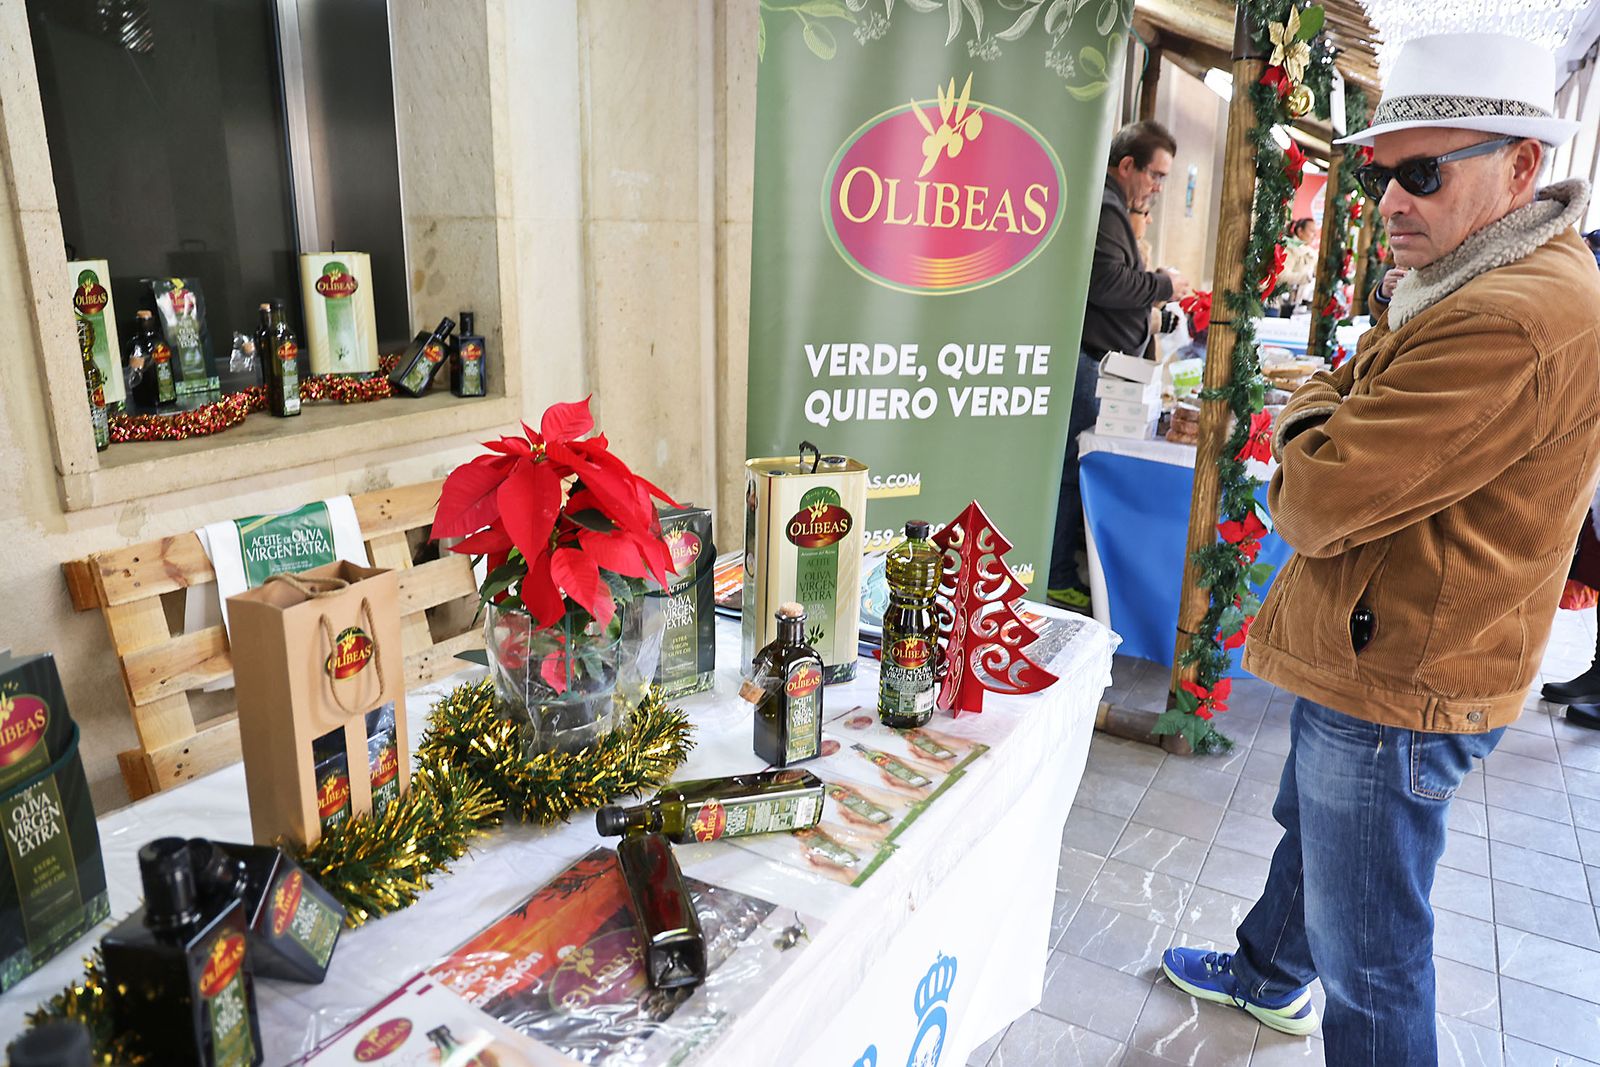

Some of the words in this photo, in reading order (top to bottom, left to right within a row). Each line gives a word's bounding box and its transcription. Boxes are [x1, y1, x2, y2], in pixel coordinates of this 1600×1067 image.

[839, 166, 1049, 235] OLIBEAS
[75, 292, 107, 305] OLIBEAS
[804, 343, 927, 382] VERDE,
[937, 343, 1006, 380] QUE
[1015, 344, 1051, 375] TE
[804, 387, 938, 428] QUIERO
[947, 386, 1051, 417] VERDE
[790, 518, 848, 536] OLIBEAS
[251, 533, 281, 548] ACEITE
[291, 528, 324, 542] OLIVA
[246, 543, 293, 562] VIRGEN
[295, 540, 331, 556] EXTRA
[804, 571, 831, 581] OLIVA
[800, 579, 835, 592] VIRGEN
[667, 594, 691, 609] OLIVA
[802, 590, 832, 602] EXTRA
[663, 602, 695, 619] VIRGEN
[666, 615, 693, 630] EXTRA
[891, 647, 931, 659] OLIBEAS
[787, 674, 820, 691] OLIBEAS
[12, 792, 51, 823] OLIVA
[8, 801, 60, 843] VIRGEN
[17, 821, 60, 857] EXTRA
